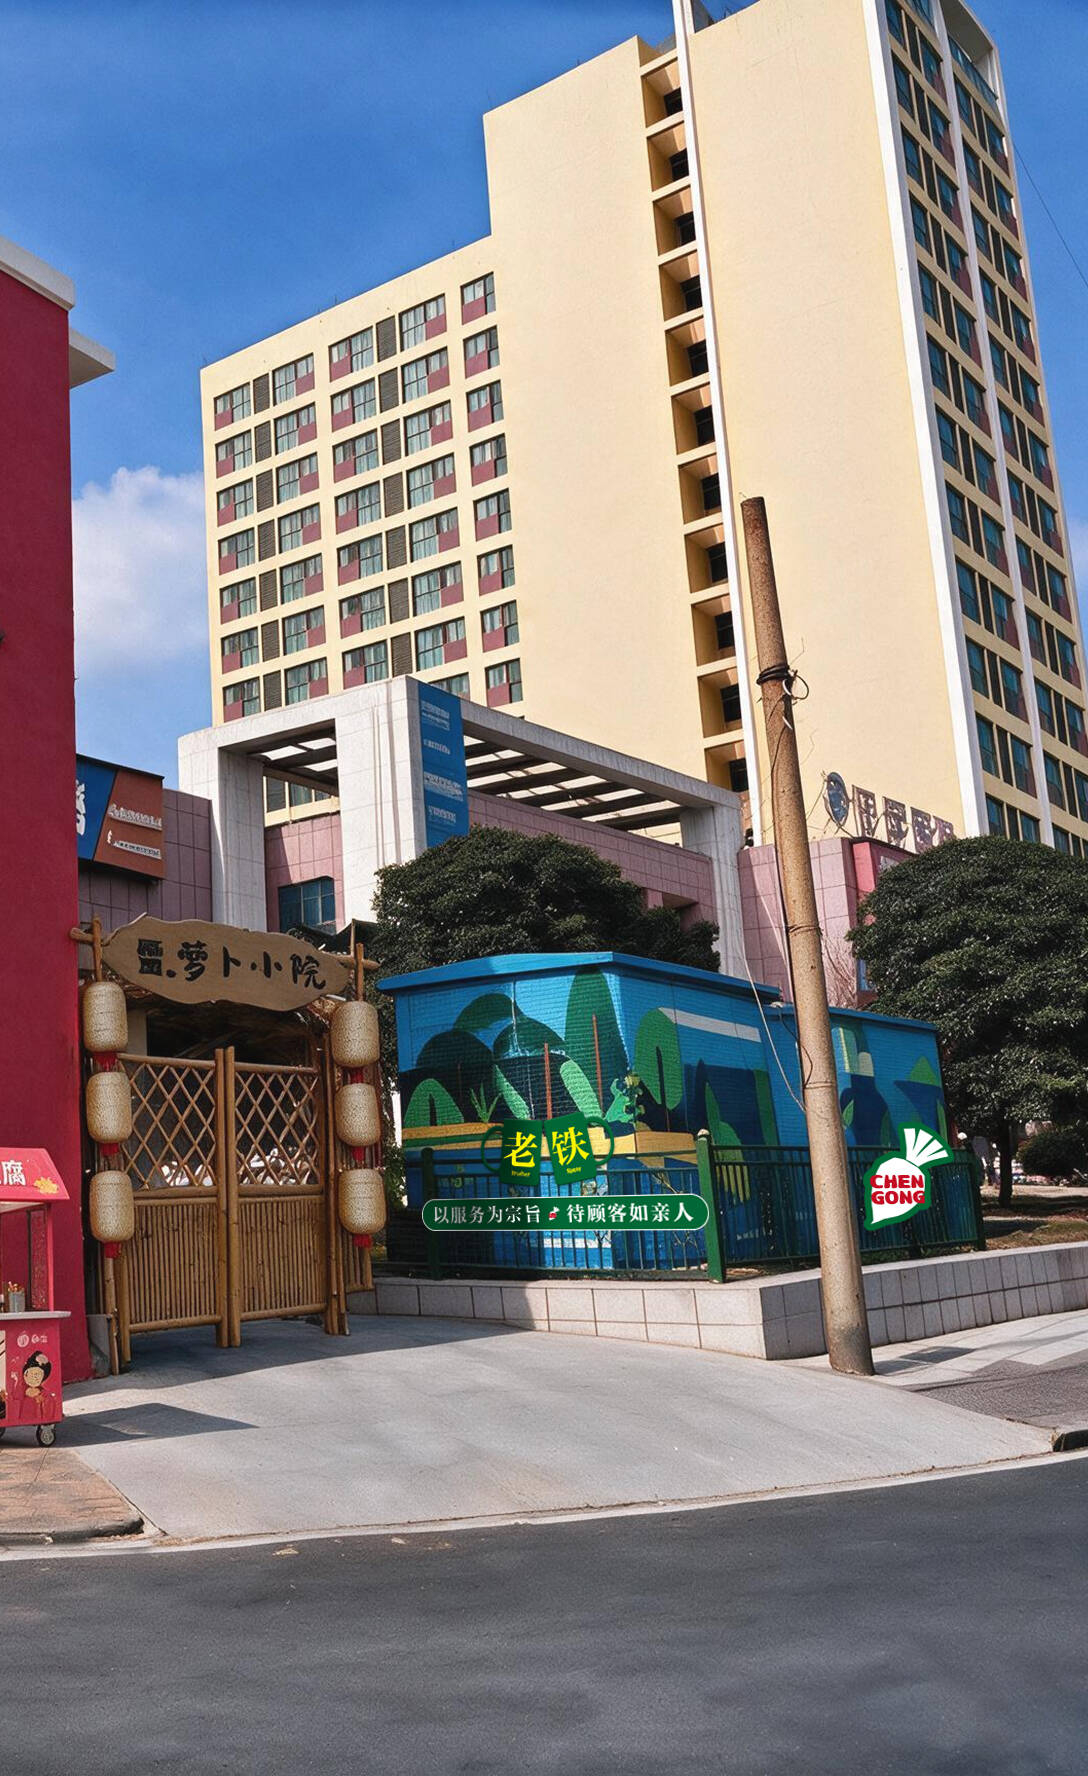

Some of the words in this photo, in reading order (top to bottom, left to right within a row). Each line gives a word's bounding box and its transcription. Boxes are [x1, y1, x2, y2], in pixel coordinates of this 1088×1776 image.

[504, 1126, 590, 1168] 老铁
[870, 1174, 924, 1189] CHEN
[871, 1190, 926, 1205] GONG
[433, 1204, 541, 1225] 以服务为宗旨
[567, 1201, 694, 1224] 待顾客如亲人
